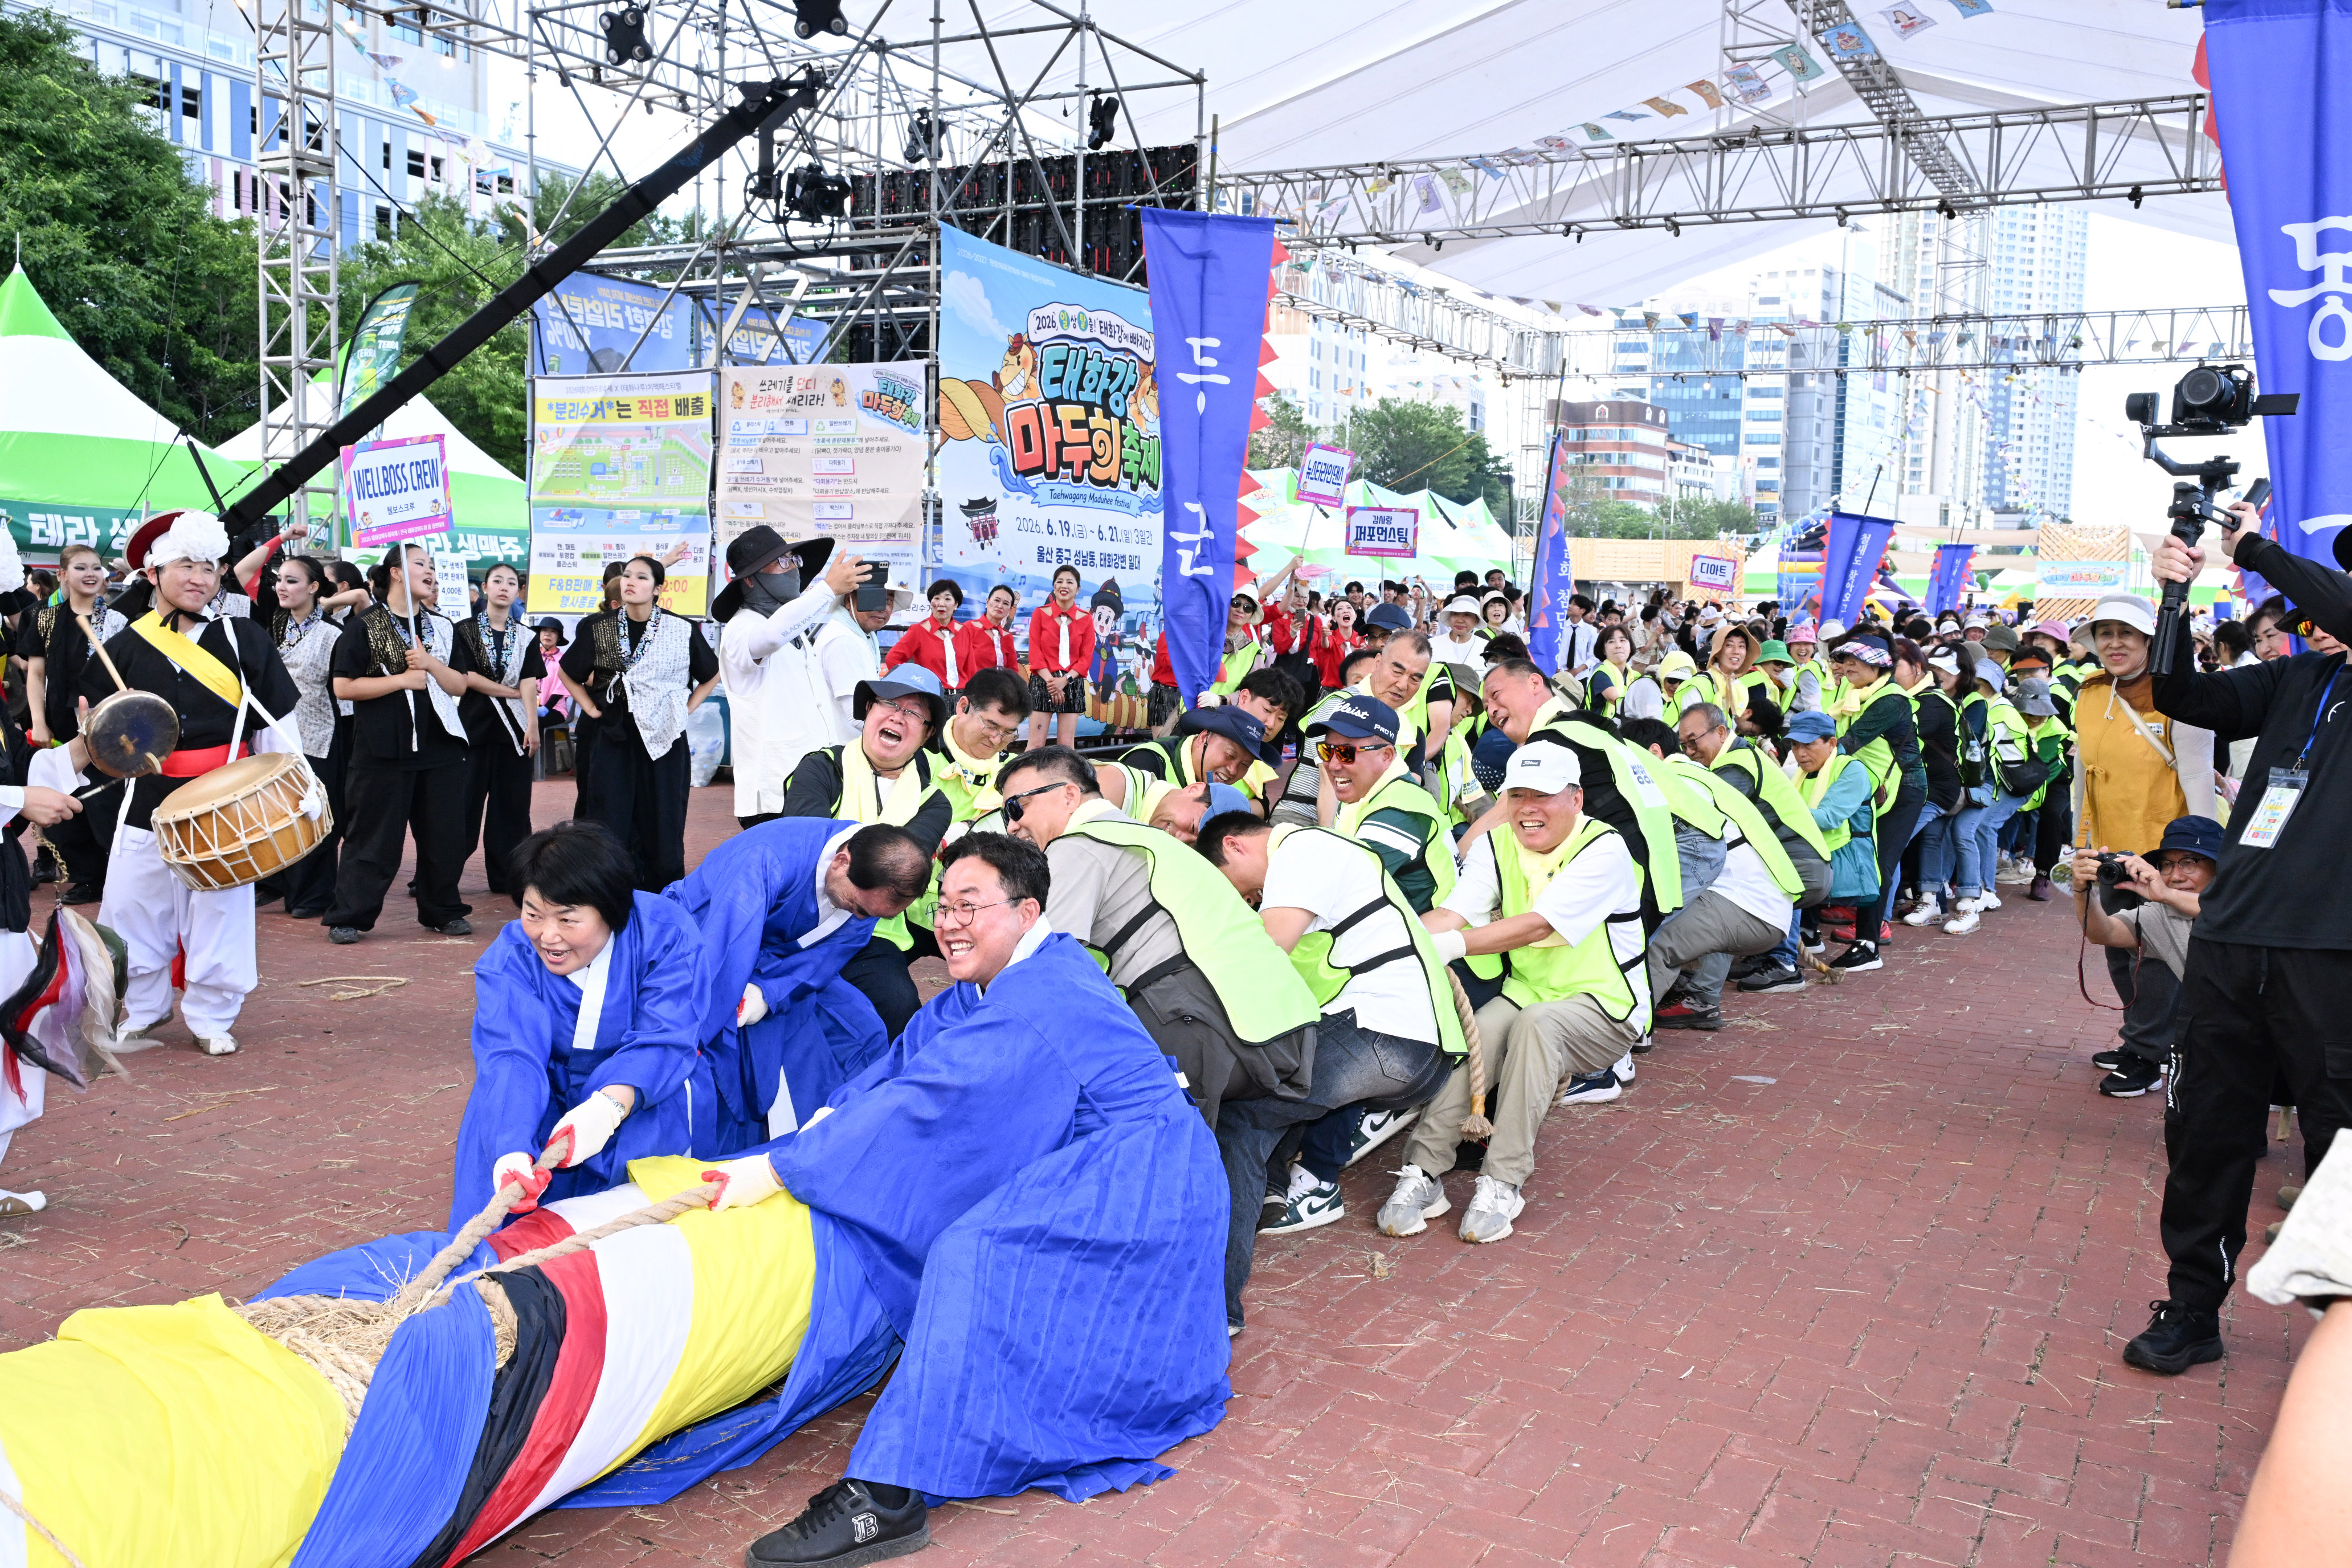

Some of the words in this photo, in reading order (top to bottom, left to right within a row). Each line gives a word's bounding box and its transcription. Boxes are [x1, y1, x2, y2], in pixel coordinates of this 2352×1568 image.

[377, 324, 402, 336] 100%
[1035, 315, 1057, 331] 2026
[1129, 332, 1151, 354] 빠지다
[357, 348, 377, 359] TERRA
[378, 340, 399, 350] TERRA
[760, 375, 793, 394] 쓰레기를
[797, 377, 816, 391] 단디
[1041, 345, 1137, 417] 태화강
[750, 394, 783, 409] 분리해서
[878, 378, 917, 406] 태화강
[638, 398, 669, 418] 직접
[675, 396, 703, 416] 배출
[353, 463, 409, 501] WELLBOSS
[410, 458, 439, 491] CREW
[1305, 459, 1345, 486] 뉴스타라인댄스
[1050, 488, 1087, 503] Taehwagang
[1088, 493, 1113, 506] Maduhee
[1114, 496, 1132, 509] festival
[1372, 515, 1393, 525] 감사랑
[28, 513, 101, 549] 테라
[1016, 517, 1044, 534] 2026.
[1134, 528, 1153, 546] 3일간
[1355, 525, 1408, 543] 퍼포먼스팀
[458, 533, 525, 562] 생맥주
[1852, 533, 1872, 566] 철새도
[1037, 545, 1054, 564] 울산
[1056, 548, 1072, 566] 중구
[1073, 550, 1098, 569] 성남동,
[1100, 550, 1127, 569] 태화강변
[1128, 555, 1141, 571] 일대
[438, 572, 448, 581] 티켓
[1700, 562, 1727, 577] 디아트
[442, 587, 462, 595] 4,000원
[549, 578, 593, 592] F&B판매
[560, 596, 597, 609] 행사종료
